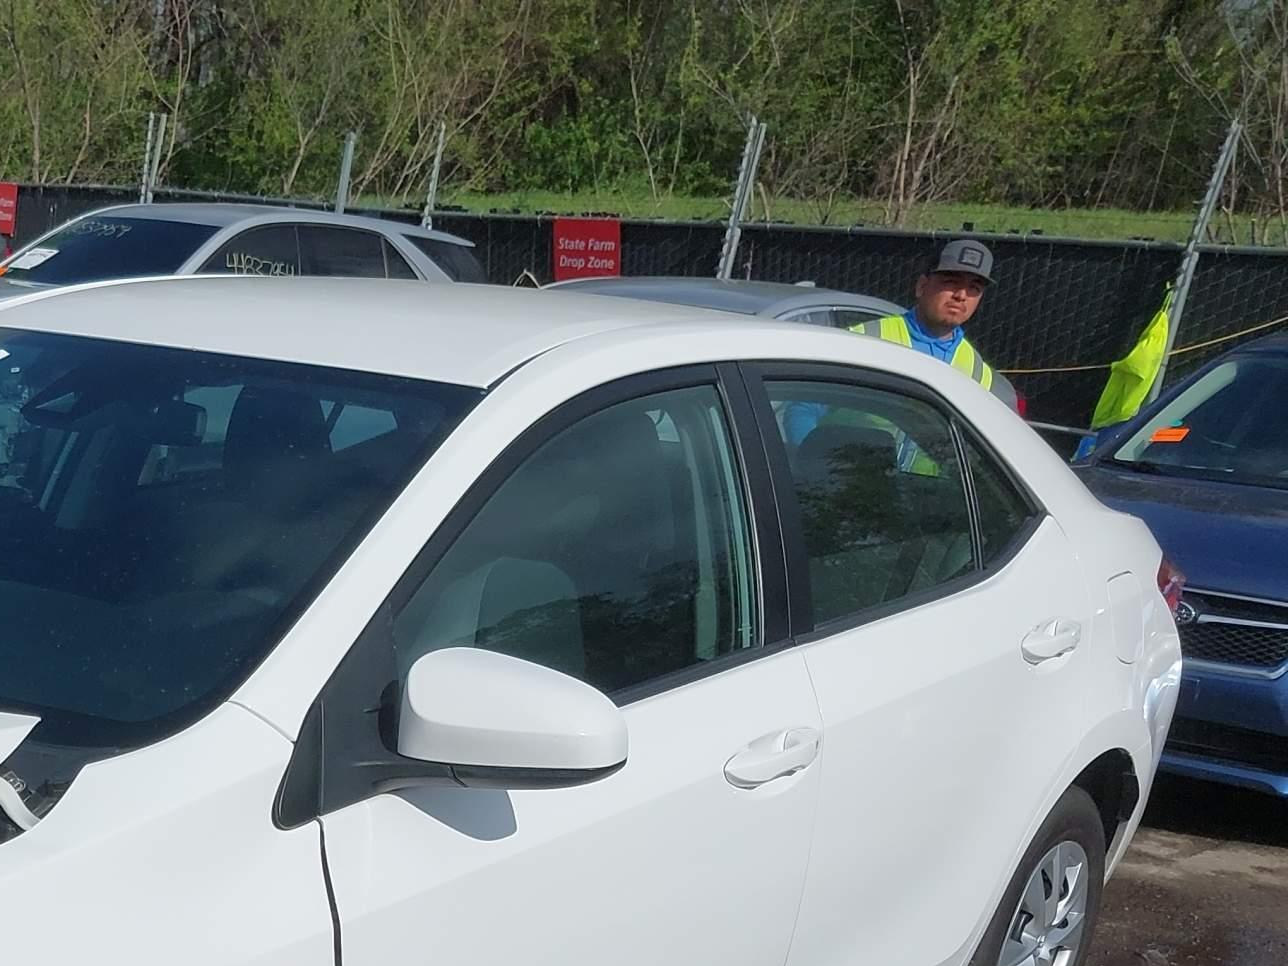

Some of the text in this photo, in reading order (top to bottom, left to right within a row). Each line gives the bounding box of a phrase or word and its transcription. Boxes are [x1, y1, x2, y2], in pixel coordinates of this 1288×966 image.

[558, 238, 615, 251] State Farm
[559, 254, 614, 270] Drop Zone
